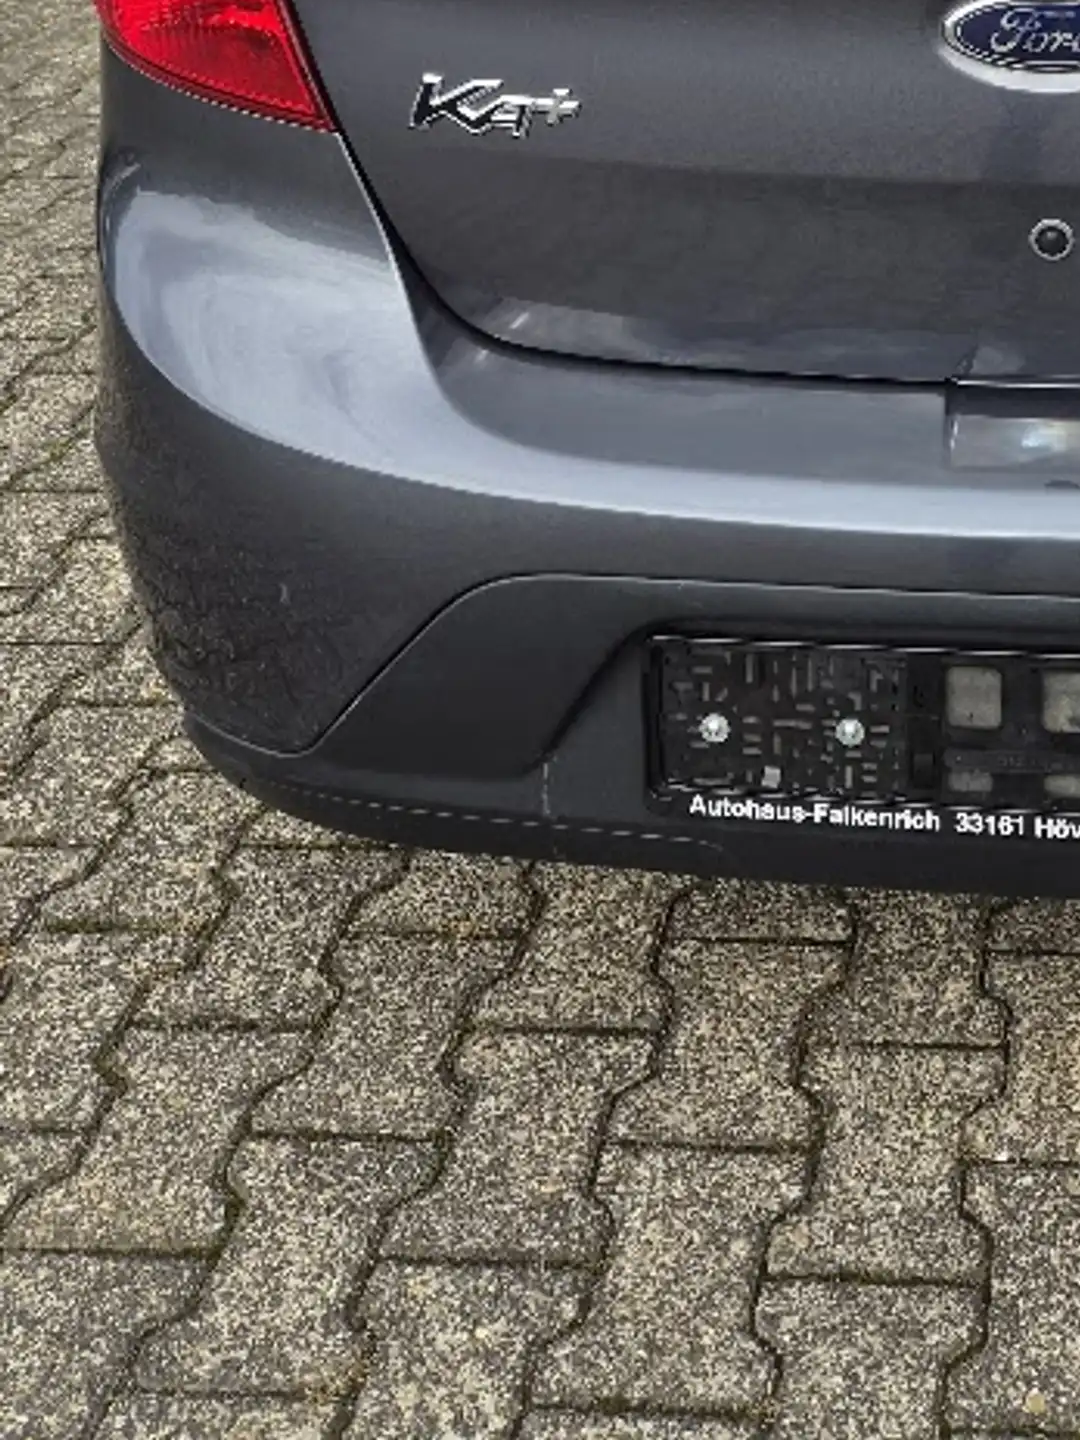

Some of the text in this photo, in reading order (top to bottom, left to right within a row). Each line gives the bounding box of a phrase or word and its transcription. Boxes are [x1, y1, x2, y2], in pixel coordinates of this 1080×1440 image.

[407, 72, 582, 139] Ka+
[689, 794, 940, 832] Autohaus-Falkenrich
[955, 812, 1024, 835] 33161
